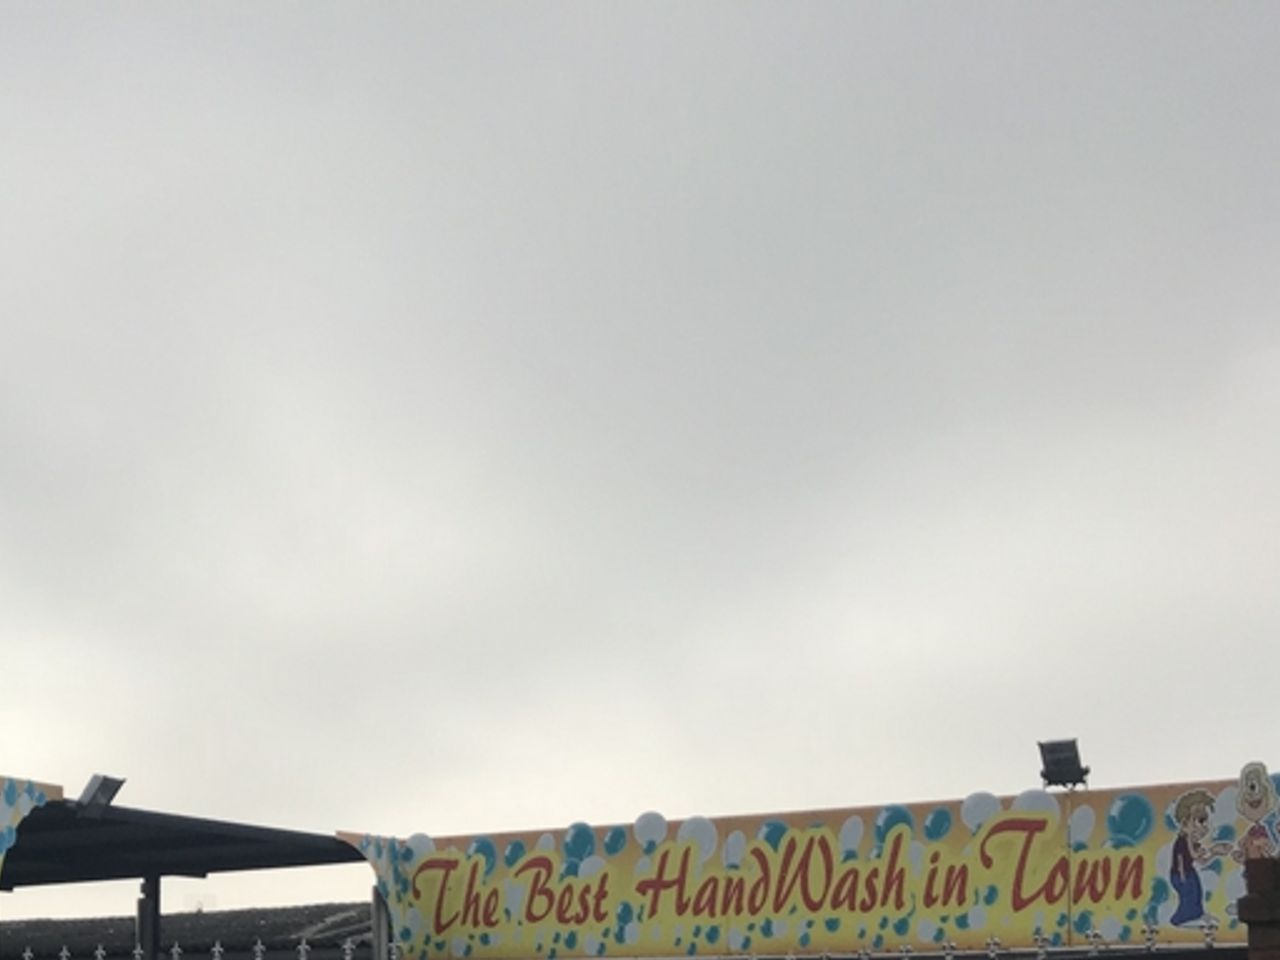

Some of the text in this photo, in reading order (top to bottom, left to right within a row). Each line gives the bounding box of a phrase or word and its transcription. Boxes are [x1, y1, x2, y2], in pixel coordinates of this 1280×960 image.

[412, 851, 499, 936] The
[514, 855, 609, 926] Best
[922, 850, 969, 910] in
[979, 817, 1145, 913] Town
